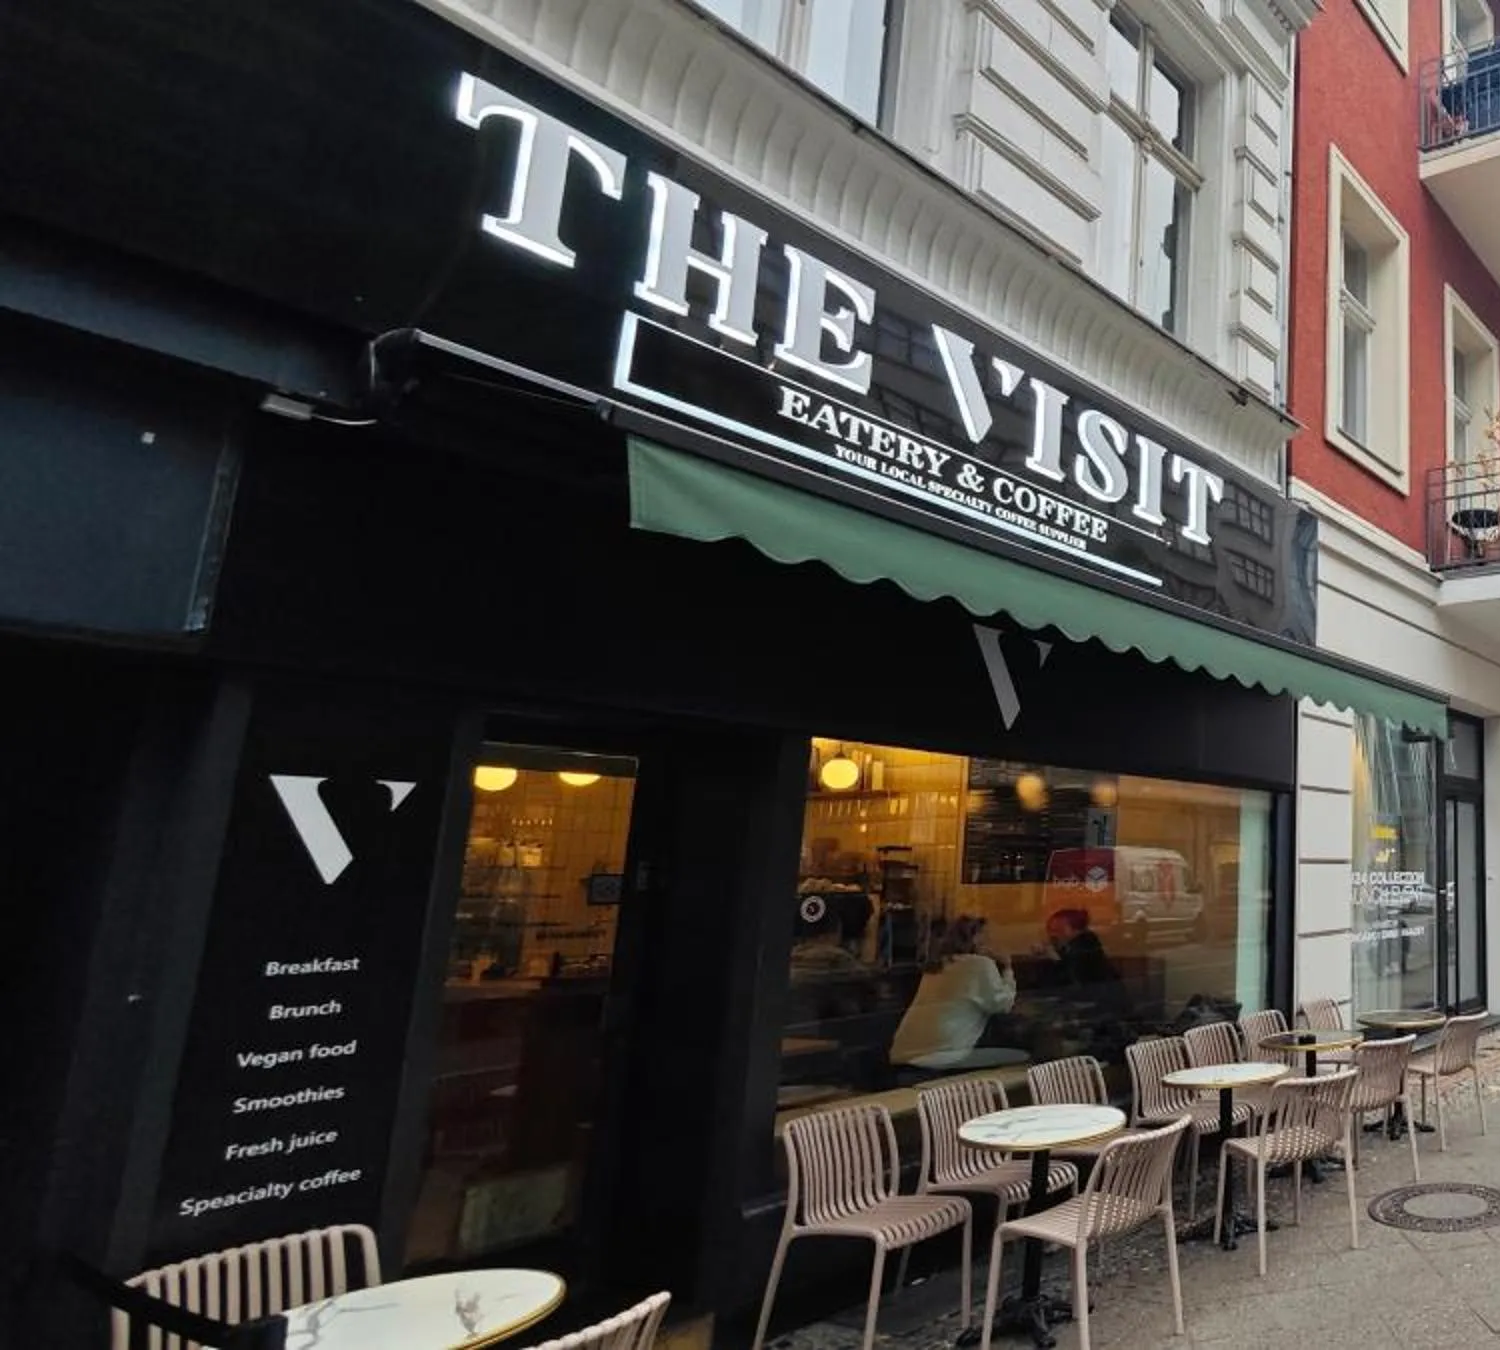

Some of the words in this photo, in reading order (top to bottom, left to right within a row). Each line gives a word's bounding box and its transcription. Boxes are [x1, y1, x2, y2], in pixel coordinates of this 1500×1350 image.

[456, 72, 876, 396] THE
[931, 322, 1225, 546] VISIT
[777, 386, 951, 478] EATERY
[956, 462, 985, 494] &
[992, 477, 1109, 543] COFFEE
[834, 444, 876, 472] YOUR
[881, 462, 928, 490] LOCAL
[927, 479, 994, 515] SPECIALTY
[995, 507, 1038, 531] COFFEE
[1038, 522, 1088, 551] SUPPLIER
[265, 957, 361, 977] Breakfast
[268, 999, 342, 1020] Brunch
[236, 1048, 304, 1069] Vegan
[309, 1039, 358, 1059] food
[232, 1085, 346, 1114] Smoothies
[224, 1137, 284, 1161] Fresh
[286, 1129, 339, 1154] juice
[179, 1182, 295, 1217] Speacialty
[298, 1167, 363, 1191] coffee
